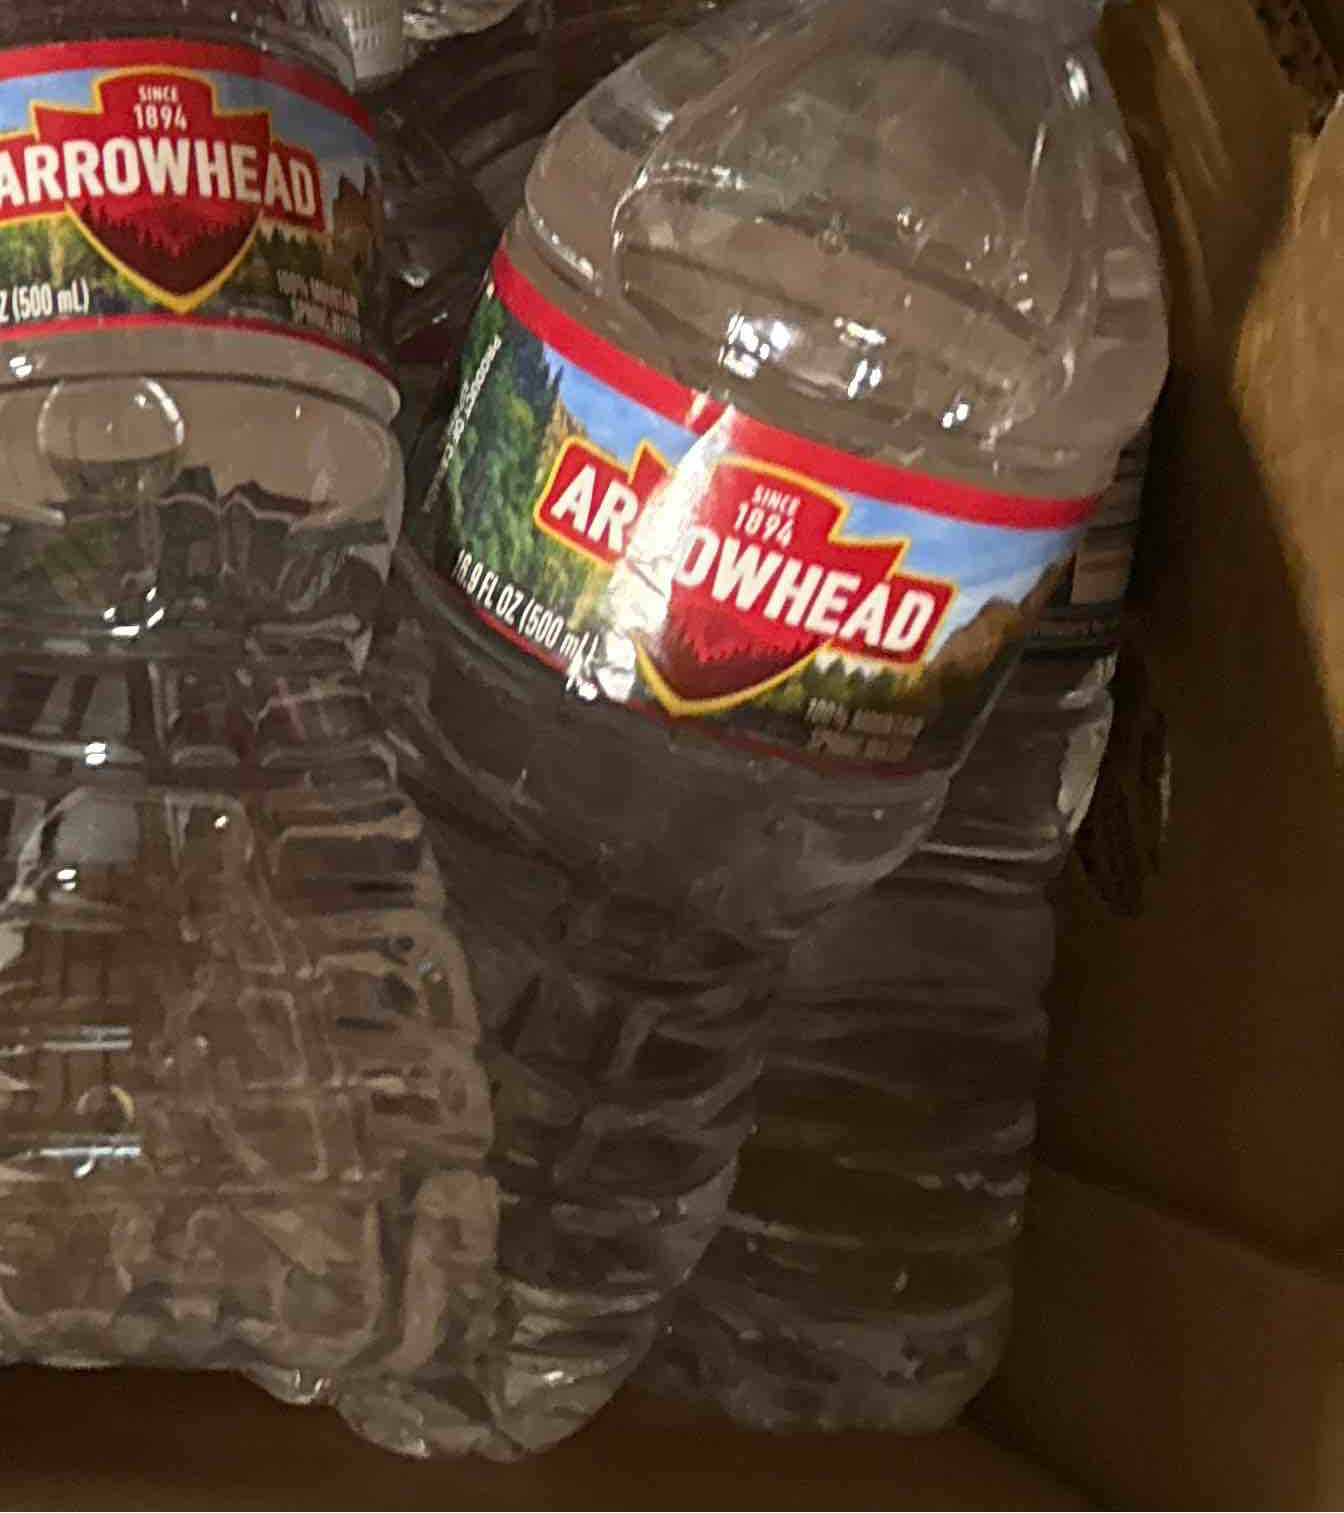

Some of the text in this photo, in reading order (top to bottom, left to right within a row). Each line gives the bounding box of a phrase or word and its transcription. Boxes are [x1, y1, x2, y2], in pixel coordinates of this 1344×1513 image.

[138, 83, 180, 103] SINCE
[132, 102, 188, 132] 1894
[12, 287, 54, 324] (500
[57, 278, 90, 315] mL)
[752, 484, 803, 515] SINCE
[732, 503, 796, 549] 1894
[550, 463, 936, 653] AROWHEAD
[477, 570, 500, 610] FL
[495, 583, 525, 626] OZ
[518, 597, 565, 649] (500
